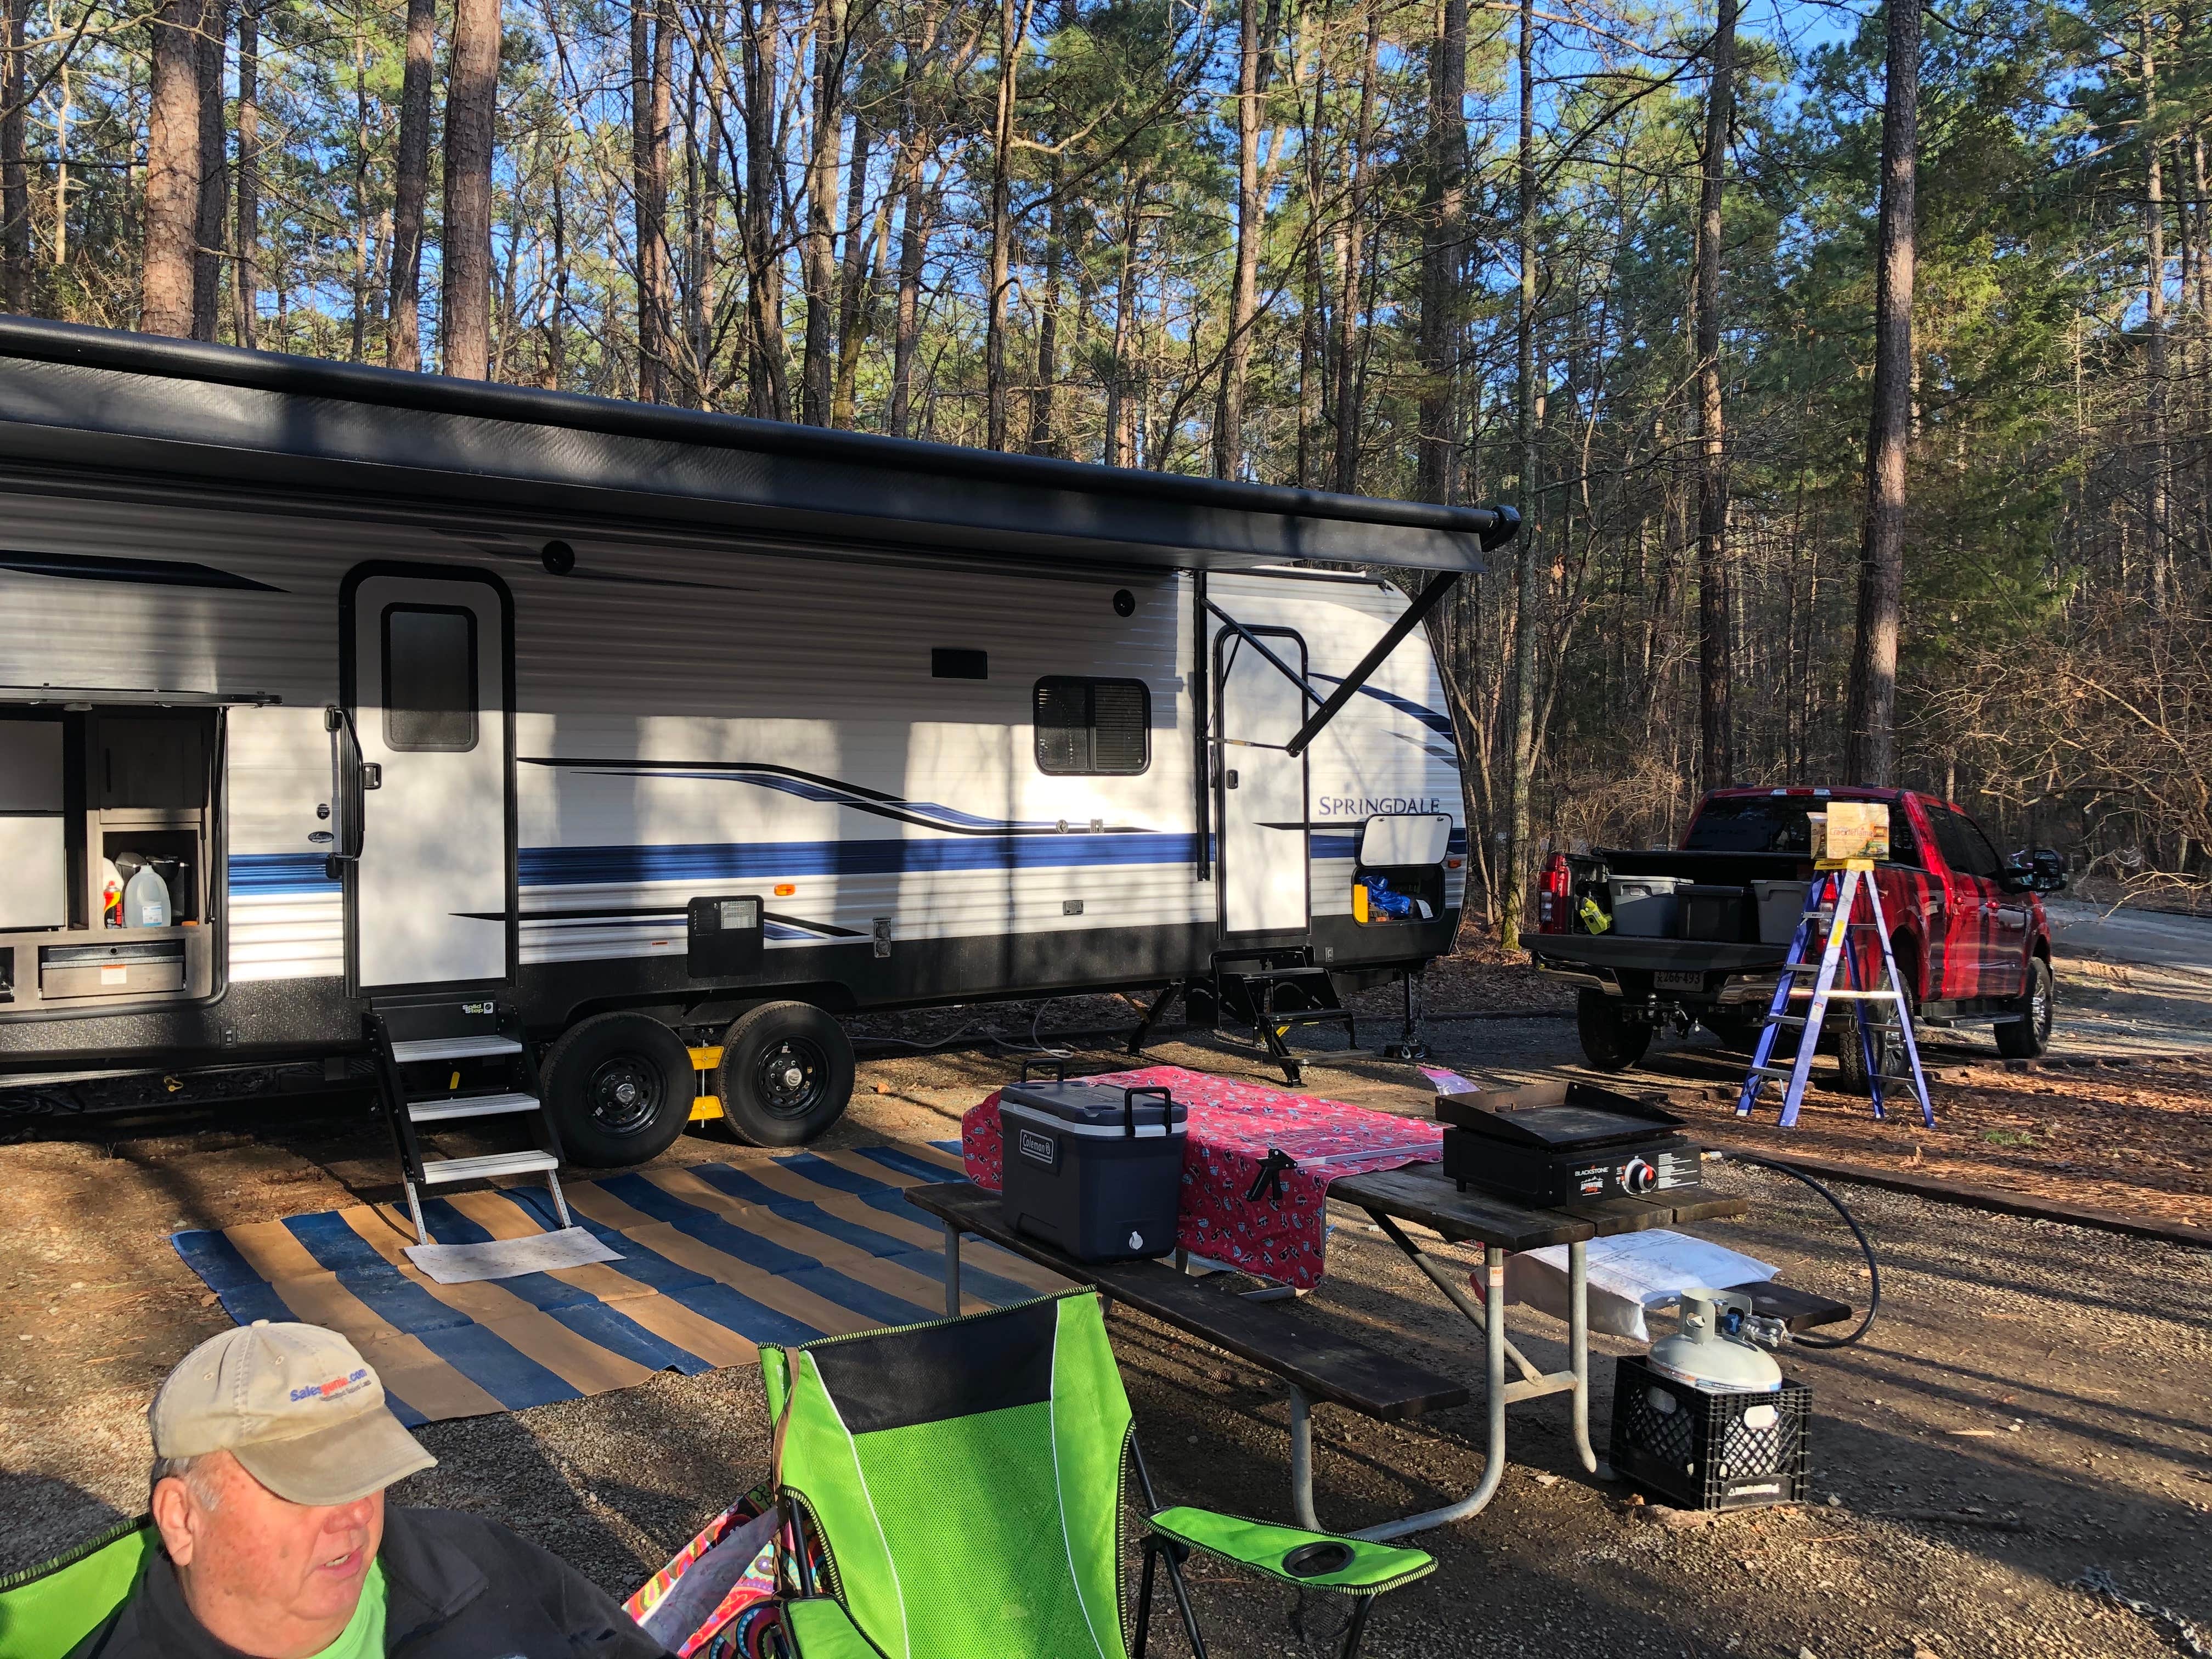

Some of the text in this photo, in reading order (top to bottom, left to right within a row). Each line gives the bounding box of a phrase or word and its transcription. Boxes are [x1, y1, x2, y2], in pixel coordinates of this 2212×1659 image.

[1319, 796, 1440, 816] SPRINGDALE
[1023, 1134, 1045, 1153] Coleman
[1575, 1167, 1610, 1176] BLACKSTONE
[290, 1368, 368, 1402] Salesgenie.com
